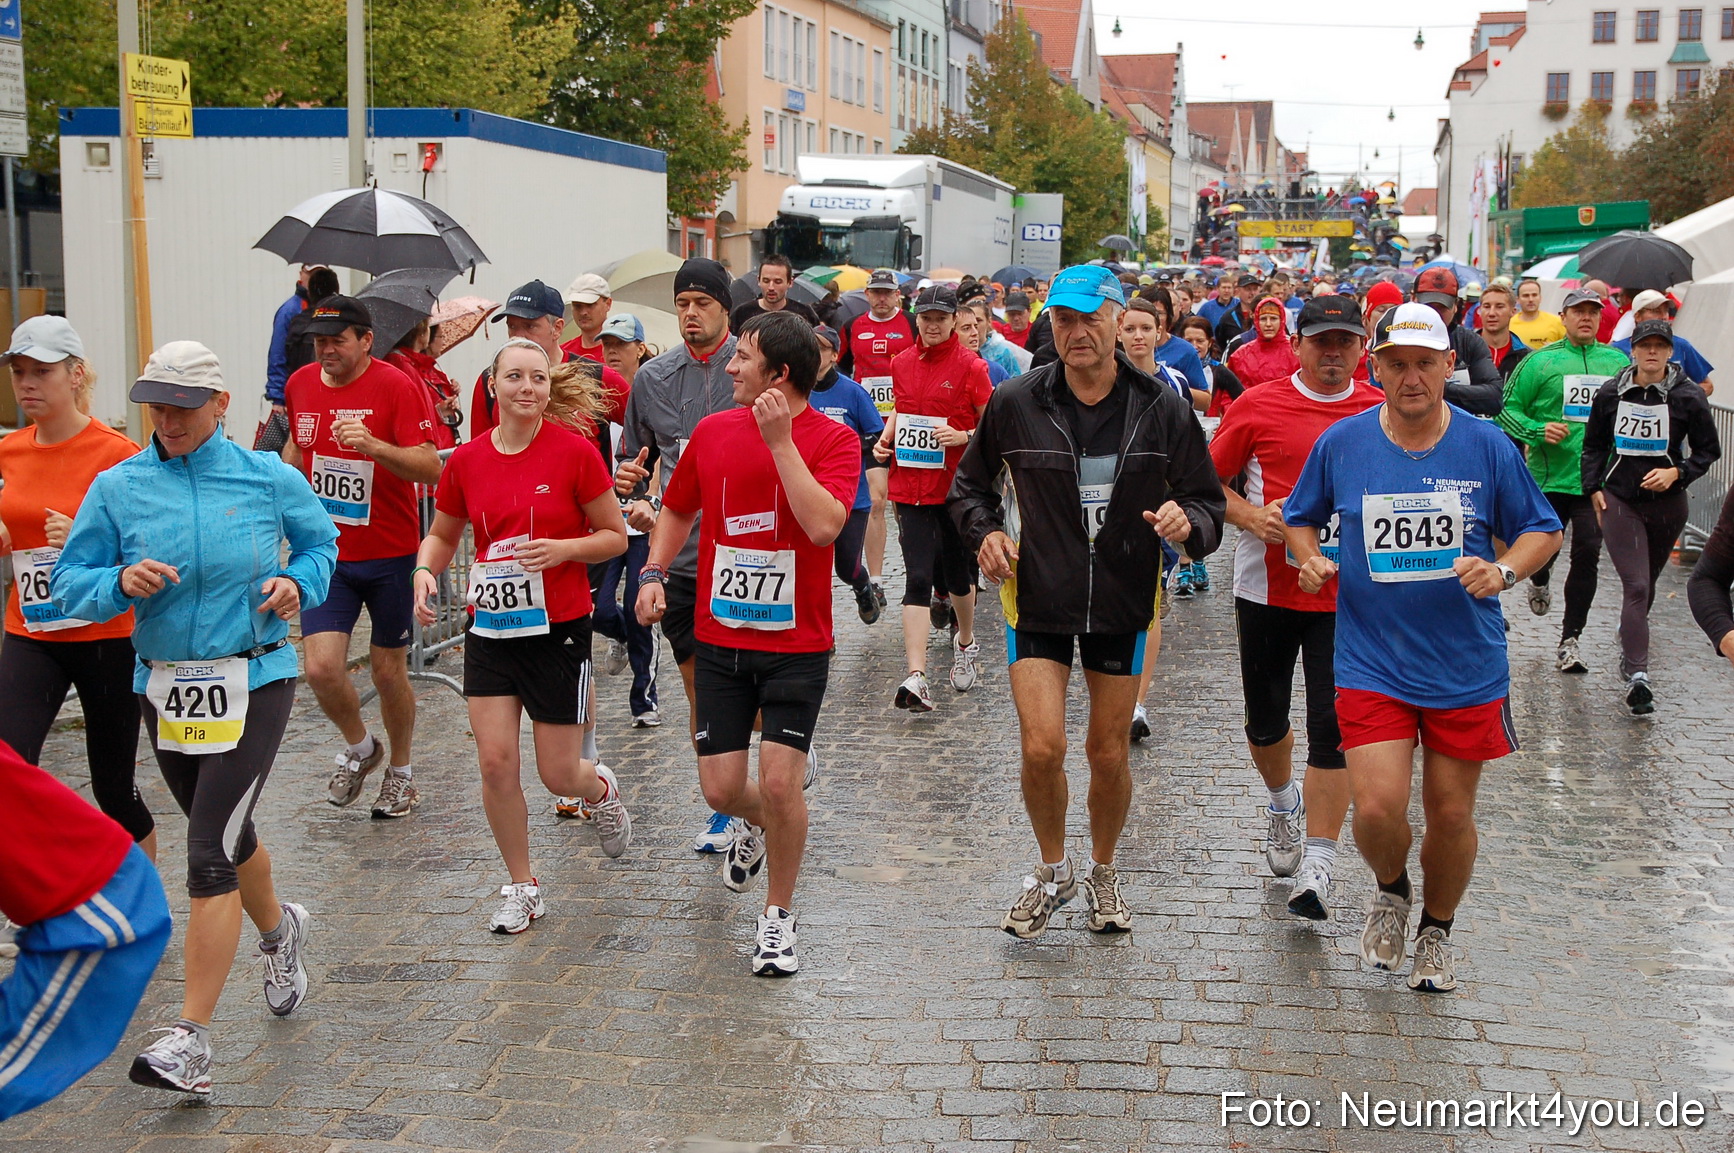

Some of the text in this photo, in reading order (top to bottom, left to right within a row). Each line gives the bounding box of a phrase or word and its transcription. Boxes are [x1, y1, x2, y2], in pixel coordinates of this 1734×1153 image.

[137, 58, 172, 77] Kinder-
[131, 76, 179, 99] betreuung
[811, 197, 871, 210] BOCK
[1274, 223, 1314, 234] START
[1385, 321, 1433, 333] GERMANY
[1579, 408, 1590, 416] Ste
[1618, 416, 1661, 438] 2751
[897, 427, 940, 450] 2585
[899, 451, 934, 461] Eva-Maria
[312, 471, 365, 502] 3063
[1422, 477, 1482, 489] 12. NEUMARKTER
[1080, 490, 1101, 499] CK
[1434, 485, 1473, 495] STADTLAUF
[326, 502, 346, 514] Fritz
[1393, 499, 1431, 509] BOCK
[739, 518, 762, 530] DEHN
[1374, 515, 1453, 550] 2643
[1391, 556, 1438, 569] Werner
[485, 565, 514, 576] BOCK
[21, 570, 51, 602] 26
[720, 568, 786, 602] 2377
[474, 580, 534, 611] 2381
[729, 605, 772, 619] Michael
[175, 666, 215, 677] BOCK
[164, 684, 228, 718] 420
[184, 726, 206, 740] Pia
